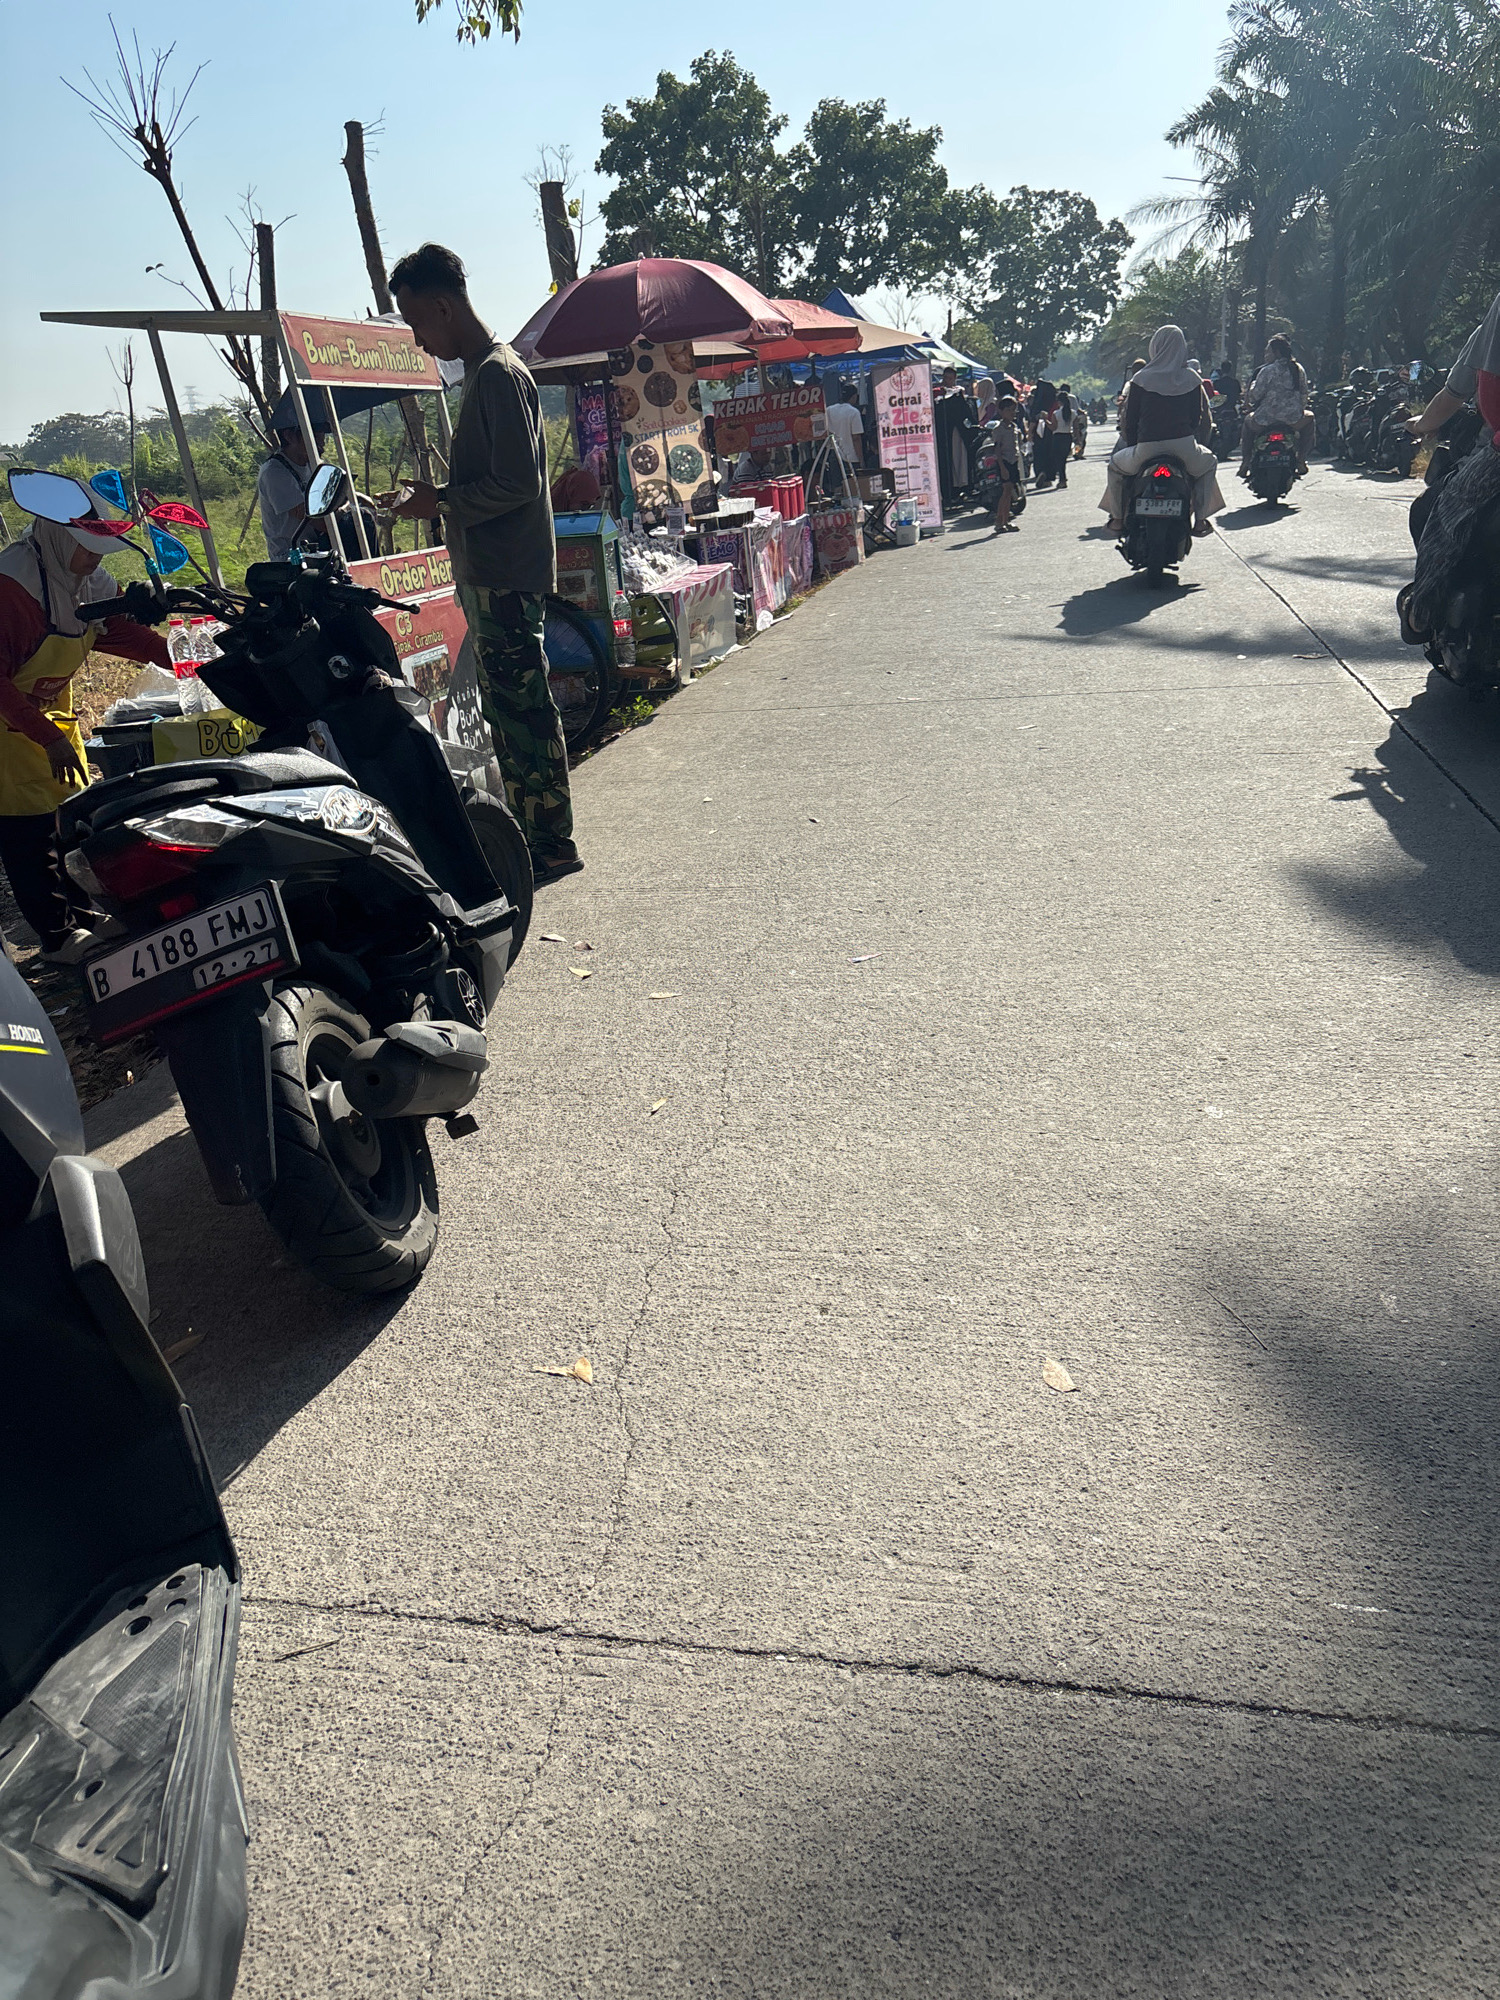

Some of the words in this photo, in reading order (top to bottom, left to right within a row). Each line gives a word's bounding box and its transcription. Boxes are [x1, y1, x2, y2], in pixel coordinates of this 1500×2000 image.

[715, 396, 767, 419] KERAK
[771, 387, 822, 410] TELOR
[888, 392, 922, 407] Gerai
[892, 408, 919, 425] Zie
[634, 431, 660, 443] START
[662, 425, 687, 437] ROM
[688, 424, 699, 433] 5K
[882, 424, 931, 438] Hamster
[812, 512, 853, 530] ELOR
[380, 561, 427, 597] Order
[426, 554, 452, 586] Her
[395, 611, 413, 636] C3
[93, 967, 111, 997] B
[132, 928, 198, 979] 4188
[207, 898, 268, 946] FMJ
[8, 1023, 45, 1045] HONDA
